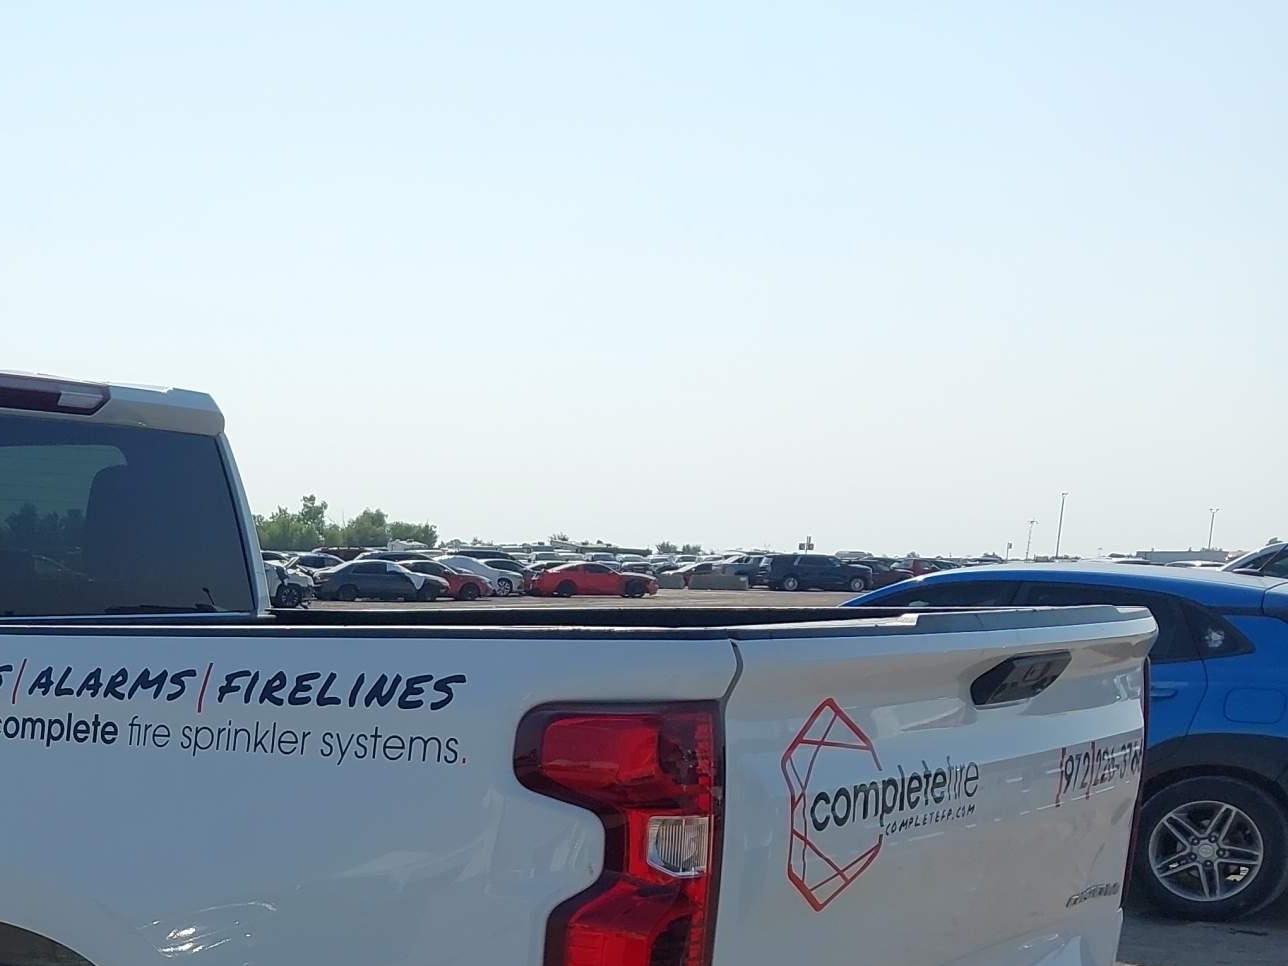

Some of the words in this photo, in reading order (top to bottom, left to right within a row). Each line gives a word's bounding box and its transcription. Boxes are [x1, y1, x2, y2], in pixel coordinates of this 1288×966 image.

[28, 665, 197, 702] ALARMS
[217, 670, 467, 711] FIRELINES
[128, 715, 171, 748] fire
[180, 719, 312, 757] sprinkler
[320, 726, 467, 766] systems.
[885, 803, 975, 836] COMPLETEFP.COM
